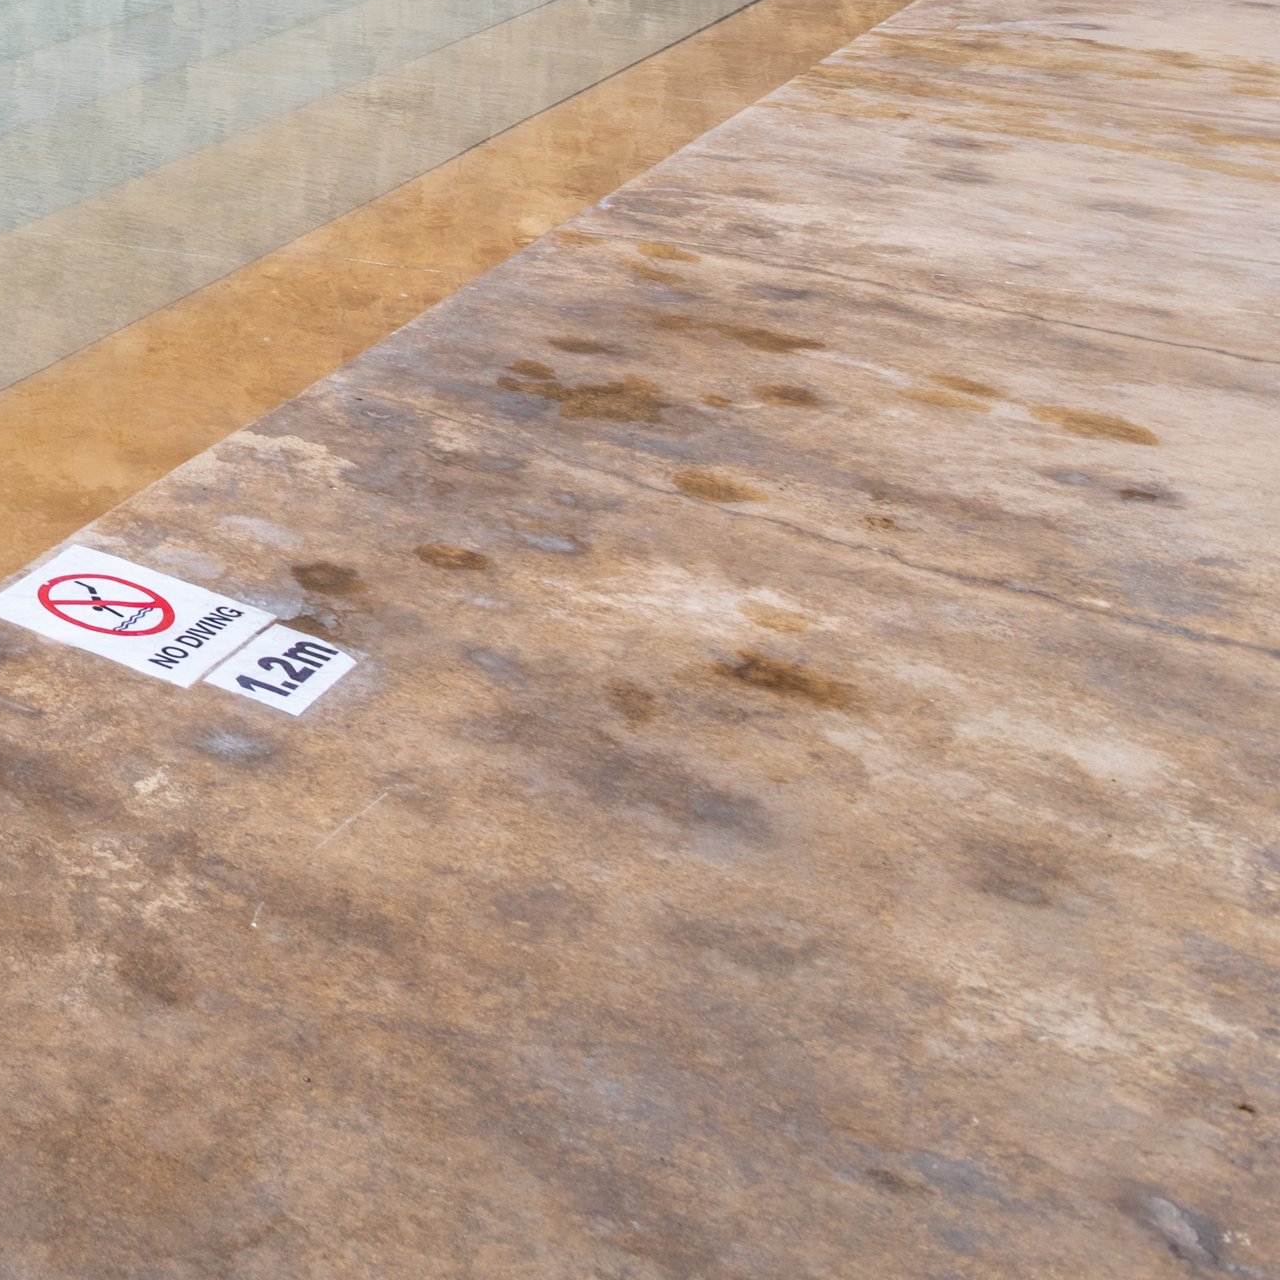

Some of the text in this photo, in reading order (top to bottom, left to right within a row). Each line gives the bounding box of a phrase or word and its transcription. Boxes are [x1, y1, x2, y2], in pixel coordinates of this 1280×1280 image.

[148, 606, 244, 669] NO DIVING
[236, 641, 339, 697] 1.2m
